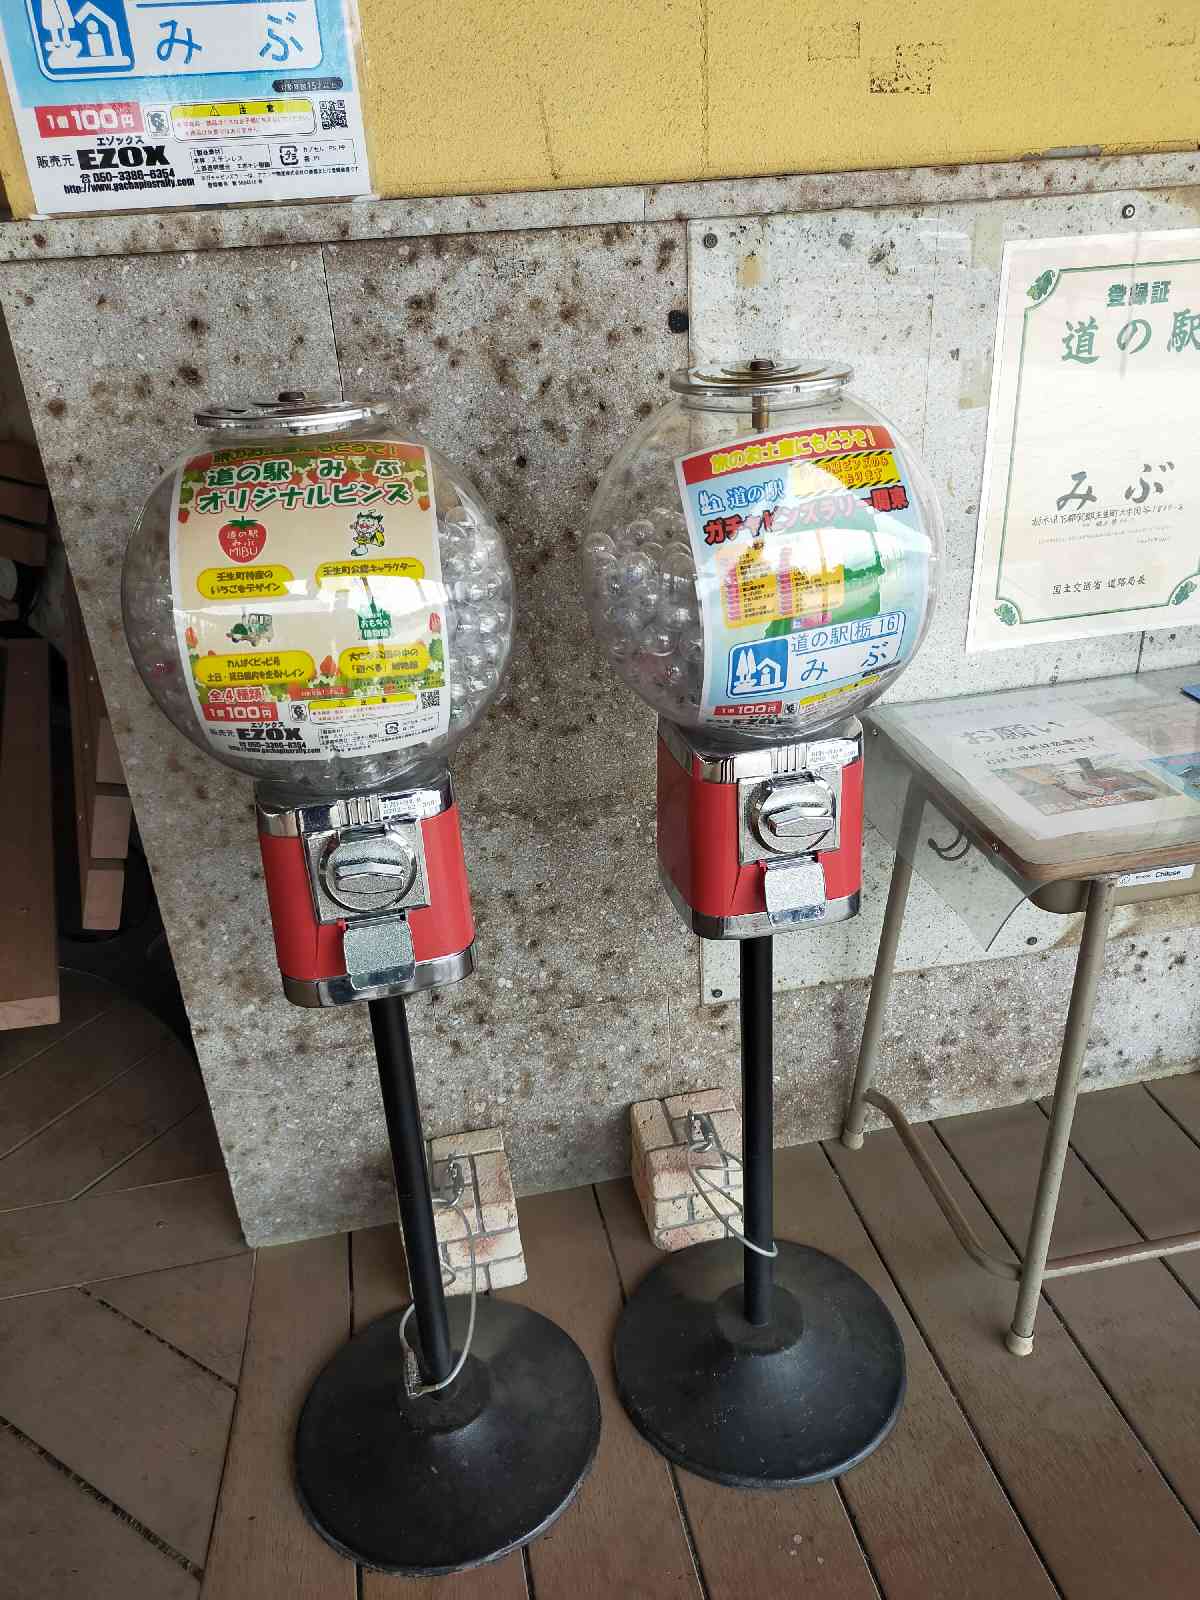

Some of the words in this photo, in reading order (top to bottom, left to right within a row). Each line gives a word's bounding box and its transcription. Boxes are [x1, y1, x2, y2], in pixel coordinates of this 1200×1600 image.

[36, 154, 75, 169] 販売元
[77, 145, 170, 170] EZOX
[1107, 281, 1171, 307] 登録証
[1062, 308, 1200, 364] 道の駅
[207, 459, 291, 487] 道の駅
[198, 483, 413, 512] オリジナルピンズ
[1056, 461, 1175, 511] みぶ
[229, 546, 259, 558] MIBU
[1052, 580, 1102, 595] 国土交通省
[1107, 574, 1146, 589] 道路局長
[791, 625, 849, 653] 道の駅
[855, 622, 872, 641] 栃
[880, 615, 896, 633] 16
[208, 687, 263, 704] 全4種類
[235, 727, 304, 741] EZOX
[962, 721, 1065, 745] お願い
